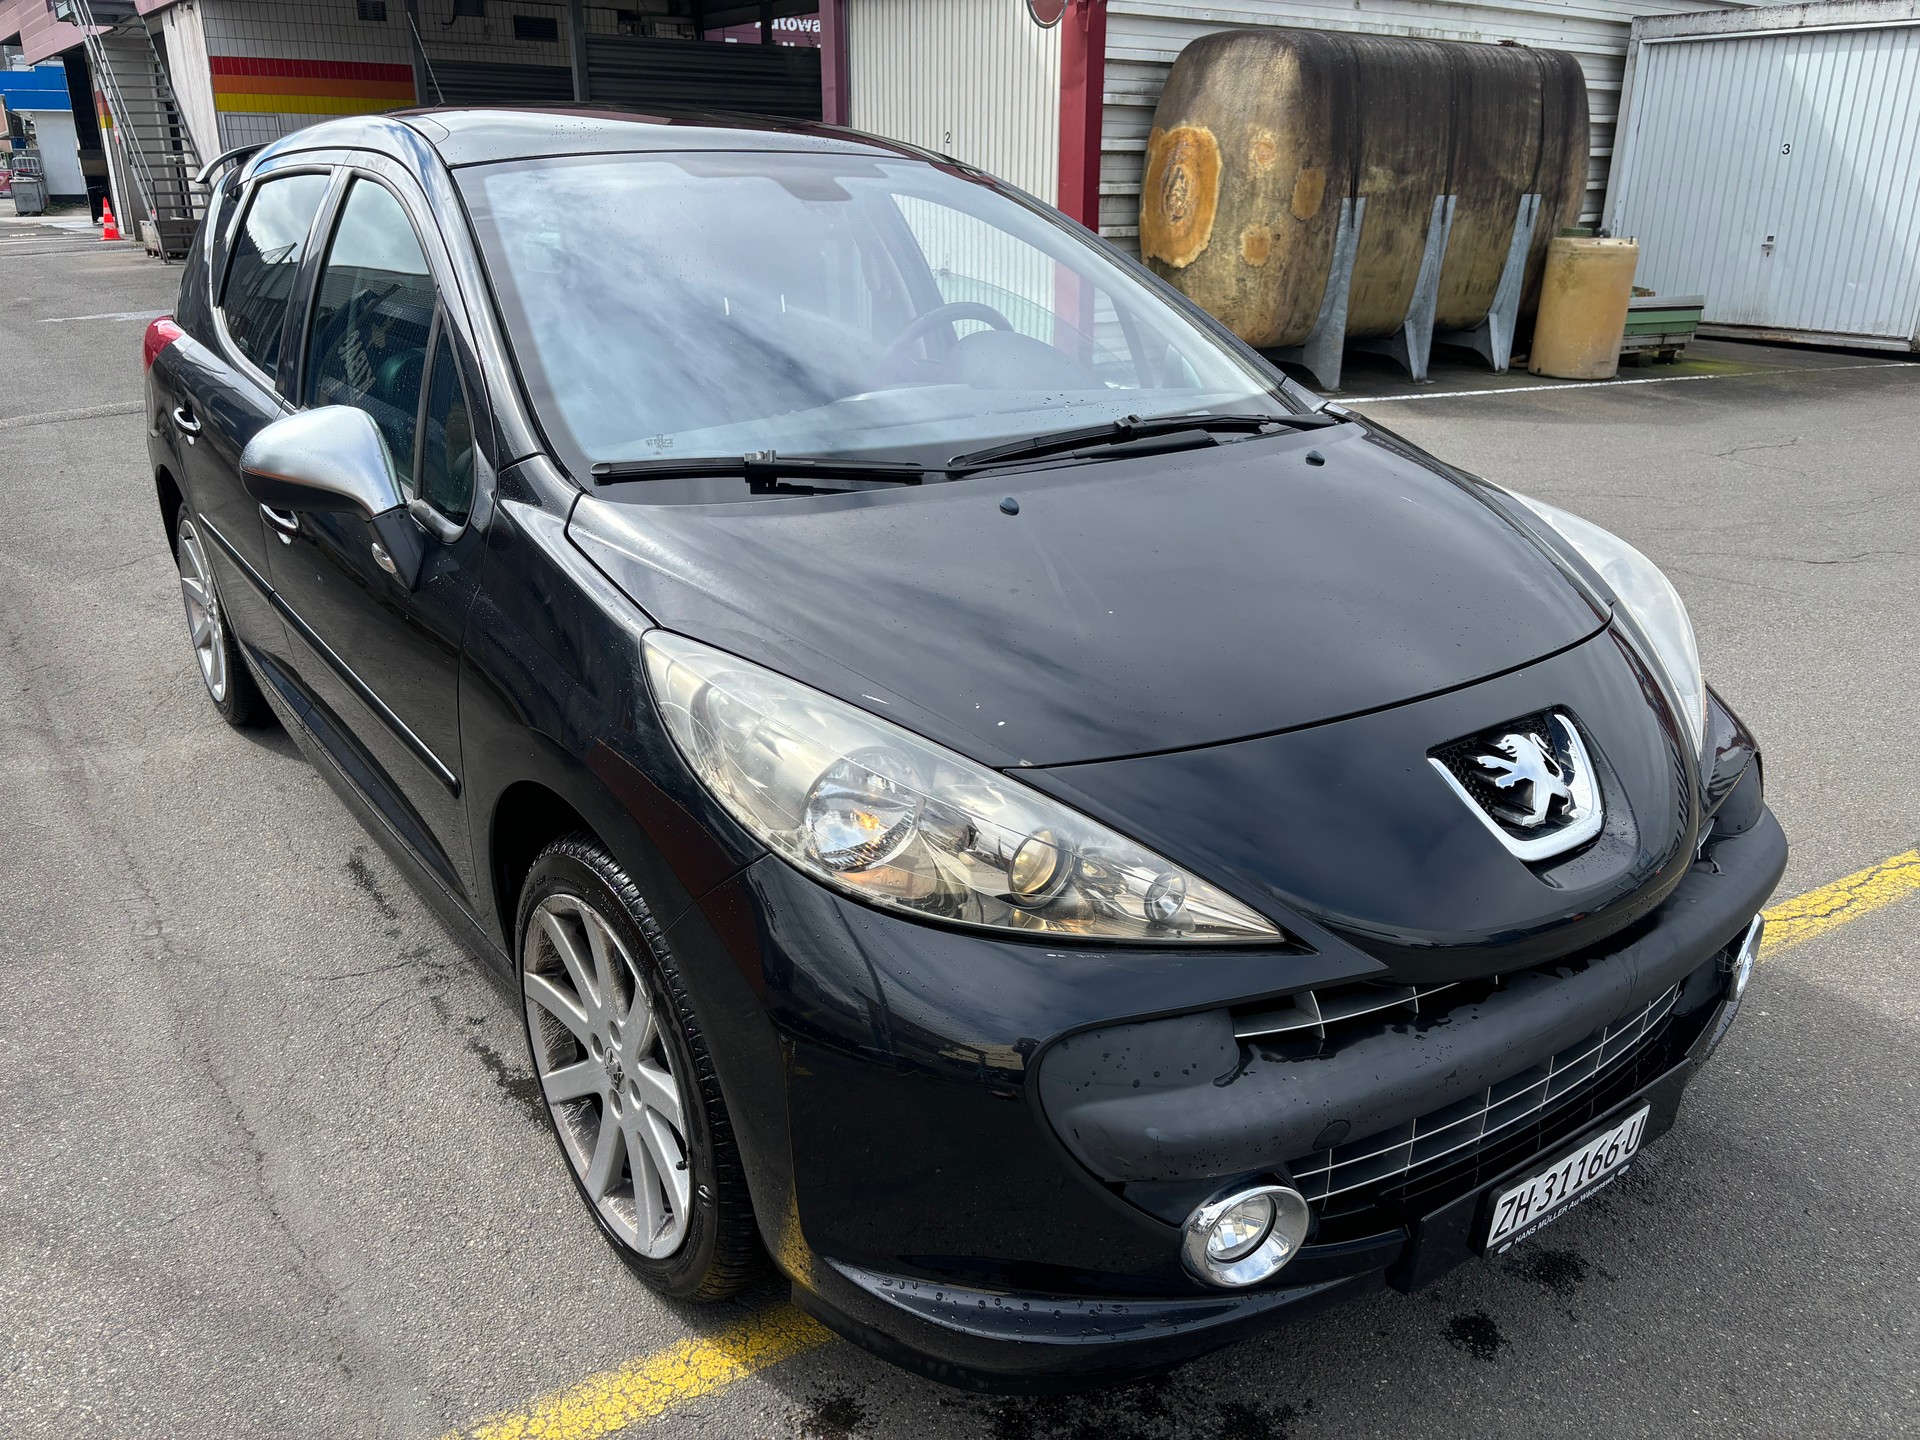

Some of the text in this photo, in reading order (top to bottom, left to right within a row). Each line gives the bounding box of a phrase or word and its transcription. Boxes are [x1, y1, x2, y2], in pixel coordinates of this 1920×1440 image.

[945, 131, 951, 143] 2
[1782, 143, 1791, 155] 3
[1514, 1224, 1537, 1245] HANS
[1537, 1204, 1568, 1230] MÜLLER
